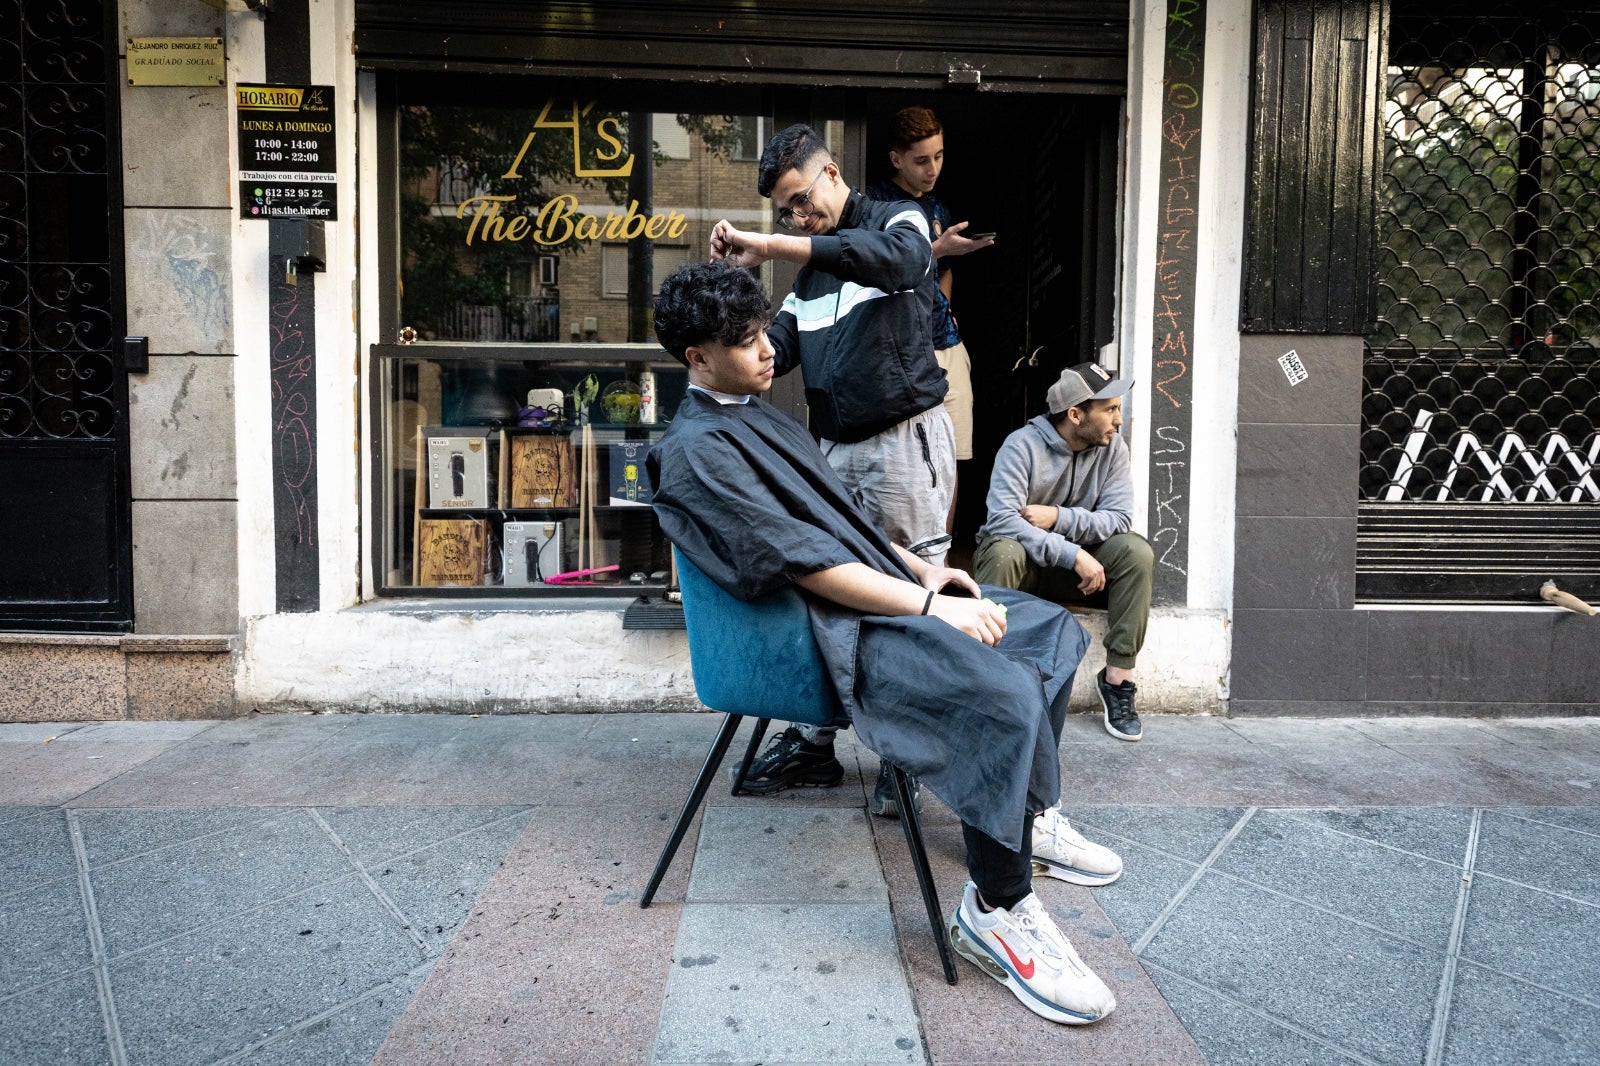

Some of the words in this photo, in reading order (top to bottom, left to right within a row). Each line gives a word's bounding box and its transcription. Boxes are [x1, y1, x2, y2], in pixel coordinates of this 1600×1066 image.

[134, 58, 182, 66] GRADUADO
[186, 58, 216, 66] SOCIAL
[239, 91, 299, 106] HORARIO
[242, 120, 274, 131] LUNES
[275, 121, 283, 131] A
[284, 121, 332, 133] DOMINGO
[254, 138, 282, 149] 10:00
[290, 140, 318, 150] 14:00
[255, 151, 283, 161] 17:00
[291, 152, 319, 162] 22:00
[242, 172, 277, 180] Trabajos
[310, 174, 335, 182] previa
[265, 188, 282, 197] 612
[284, 188, 297, 197] 52
[298, 189, 310, 198] 95
[311, 189, 323, 198] 22
[261, 205, 330, 216] ilias.the.barber
[456, 194, 532, 247] The
[533, 194, 688, 246] Barber
[441, 500, 474, 508] SENIOR
